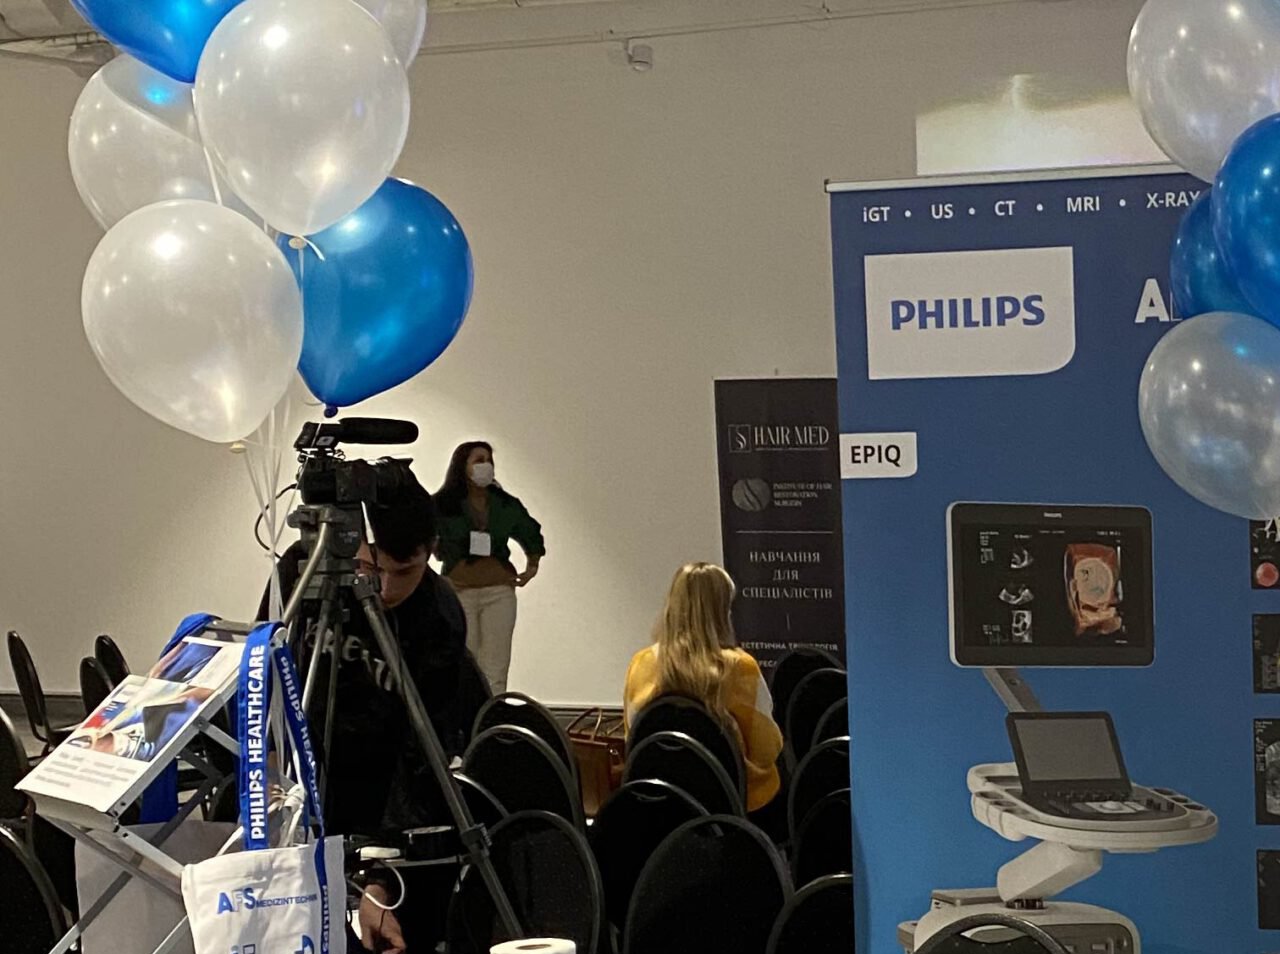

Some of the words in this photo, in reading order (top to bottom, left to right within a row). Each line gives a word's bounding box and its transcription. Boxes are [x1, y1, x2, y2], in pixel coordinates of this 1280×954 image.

[863, 206, 890, 222] iGT
[931, 203, 953, 219] US
[994, 200, 1016, 216] CT
[1066, 196, 1101, 212] MRI
[1146, 190, 1201, 208] X-RAY
[890, 294, 1046, 331] PHILIPS
[754, 426, 791, 446] HAIR
[794, 425, 830, 445] MED
[850, 444, 902, 467] EPIQ
[749, 551, 821, 563] НАВЧАННЯ
[772, 569, 800, 581] ДЛЯ
[248, 644, 265, 763] HEALTHCARE
[281, 656, 304, 722] PHILIPS
[249, 767, 265, 840] PHILIPS
[216, 887, 257, 915] AFS
